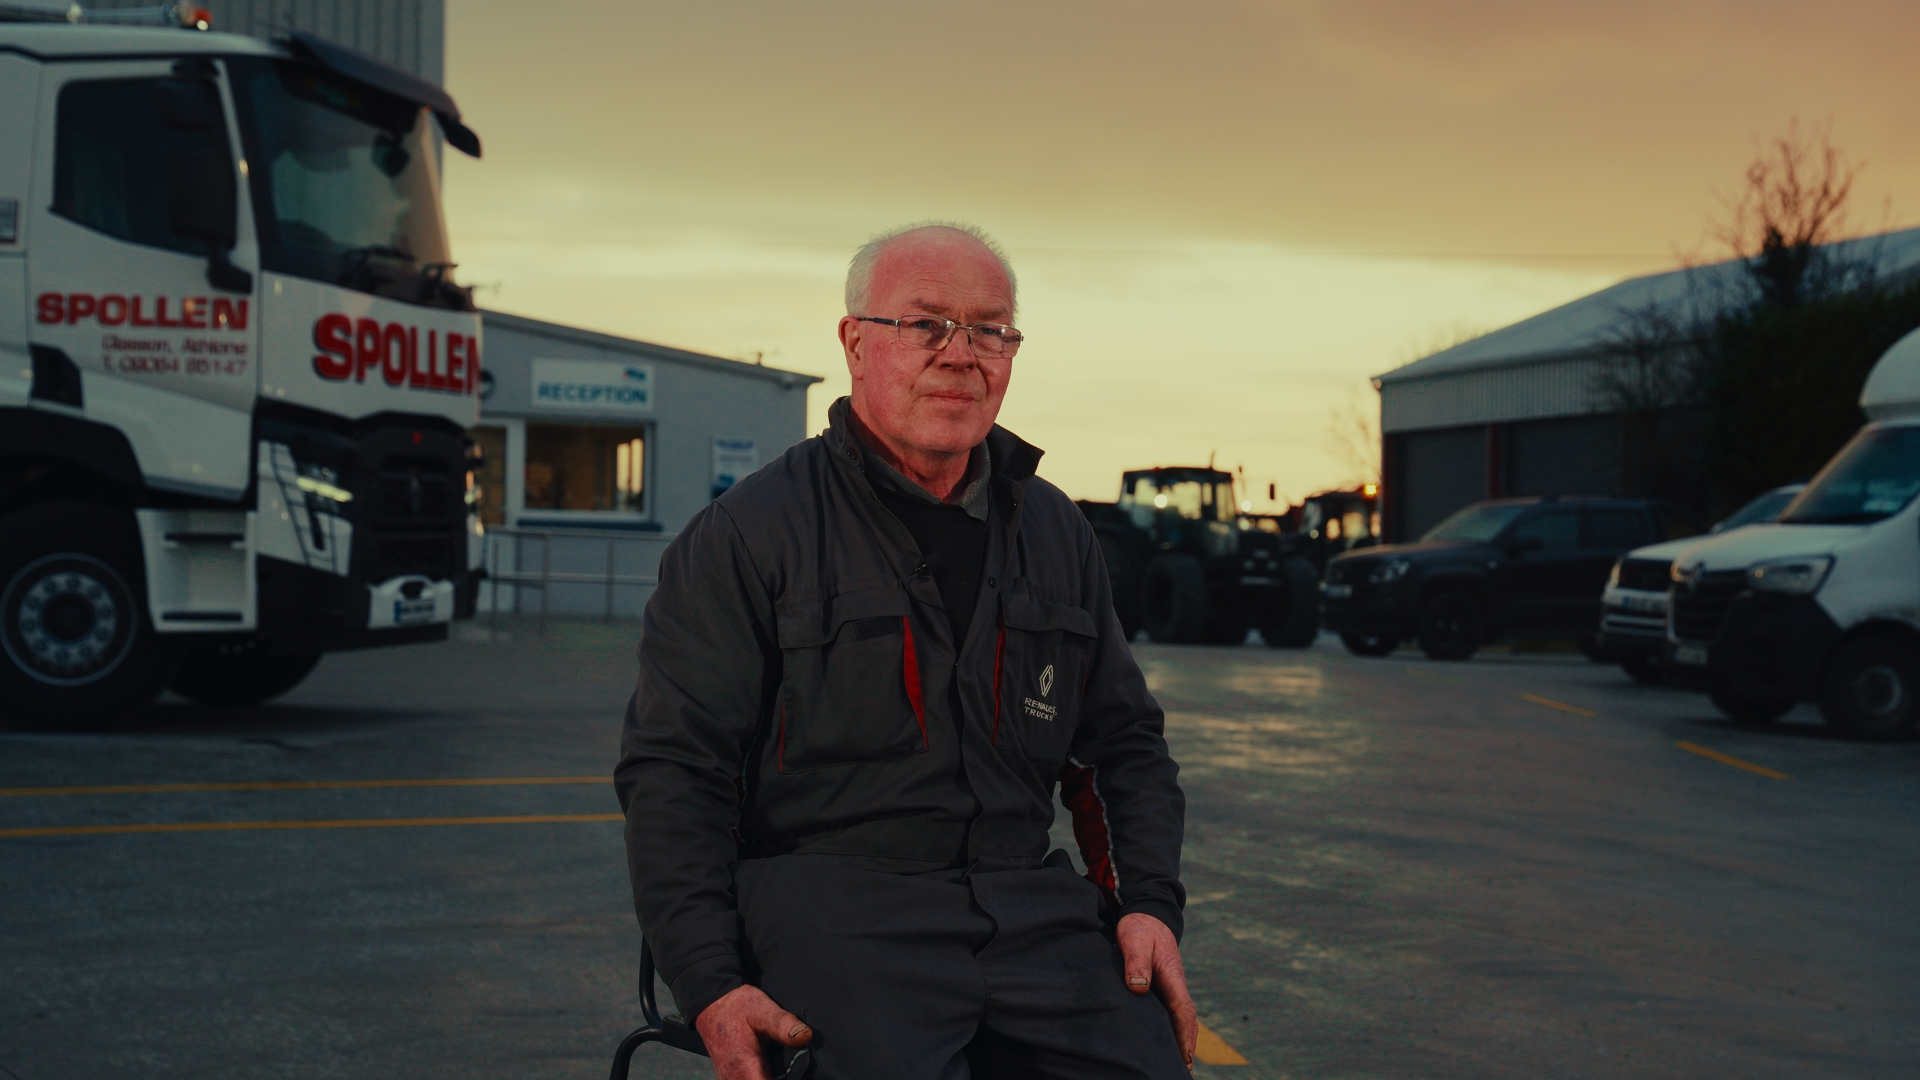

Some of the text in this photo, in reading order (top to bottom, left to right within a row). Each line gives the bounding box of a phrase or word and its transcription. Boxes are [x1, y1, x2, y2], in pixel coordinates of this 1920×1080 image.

[37, 293, 248, 330] SPOLLEN
[182, 337, 247, 355] Athlone
[537, 382, 647, 403] RECEPTION
[1024, 706, 1054, 722] TRUCKS
